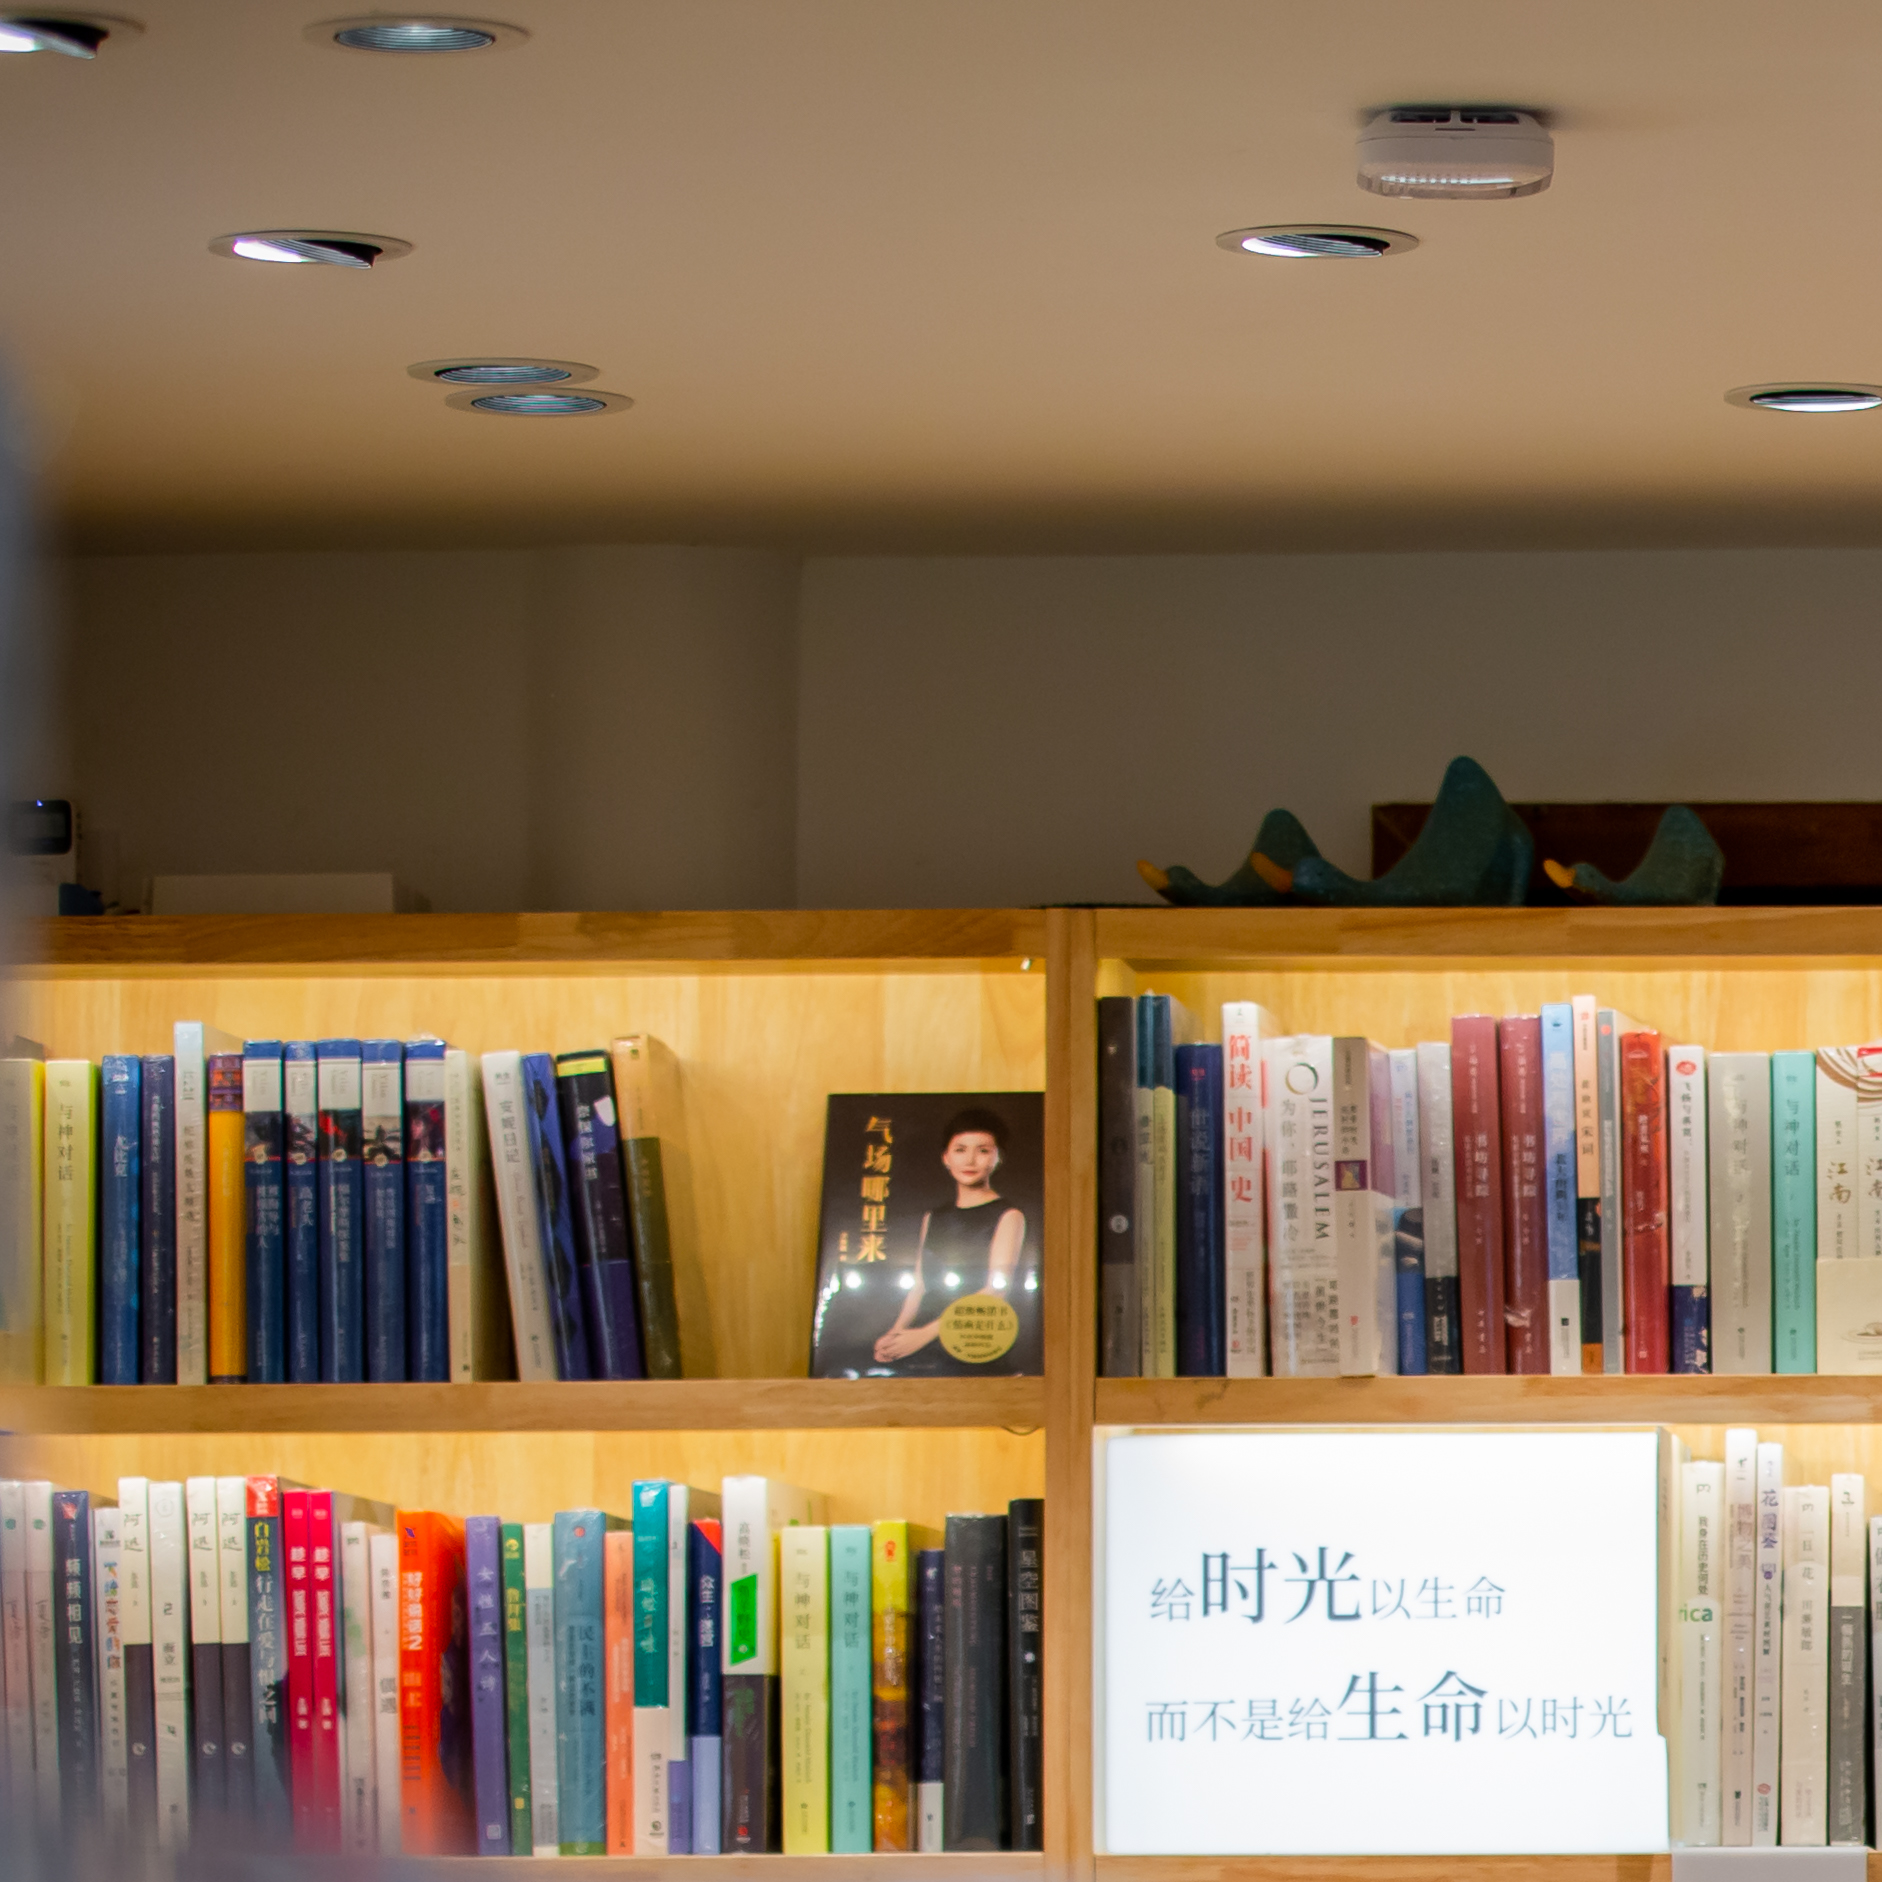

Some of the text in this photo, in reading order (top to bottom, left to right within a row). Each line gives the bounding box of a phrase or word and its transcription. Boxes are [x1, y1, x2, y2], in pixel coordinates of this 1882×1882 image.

[1227, 1033, 1256, 1204] 简读中国史
[1312, 1097, 1331, 1242] JERUSALEM
[857, 1115, 894, 1264] 气场哪里来
[254, 1522, 272, 1573] 白岩松
[1150, 1545, 1507, 1625] 给时光以生命
[1145, 1669, 1634, 1744] 而不是给生命以时光
